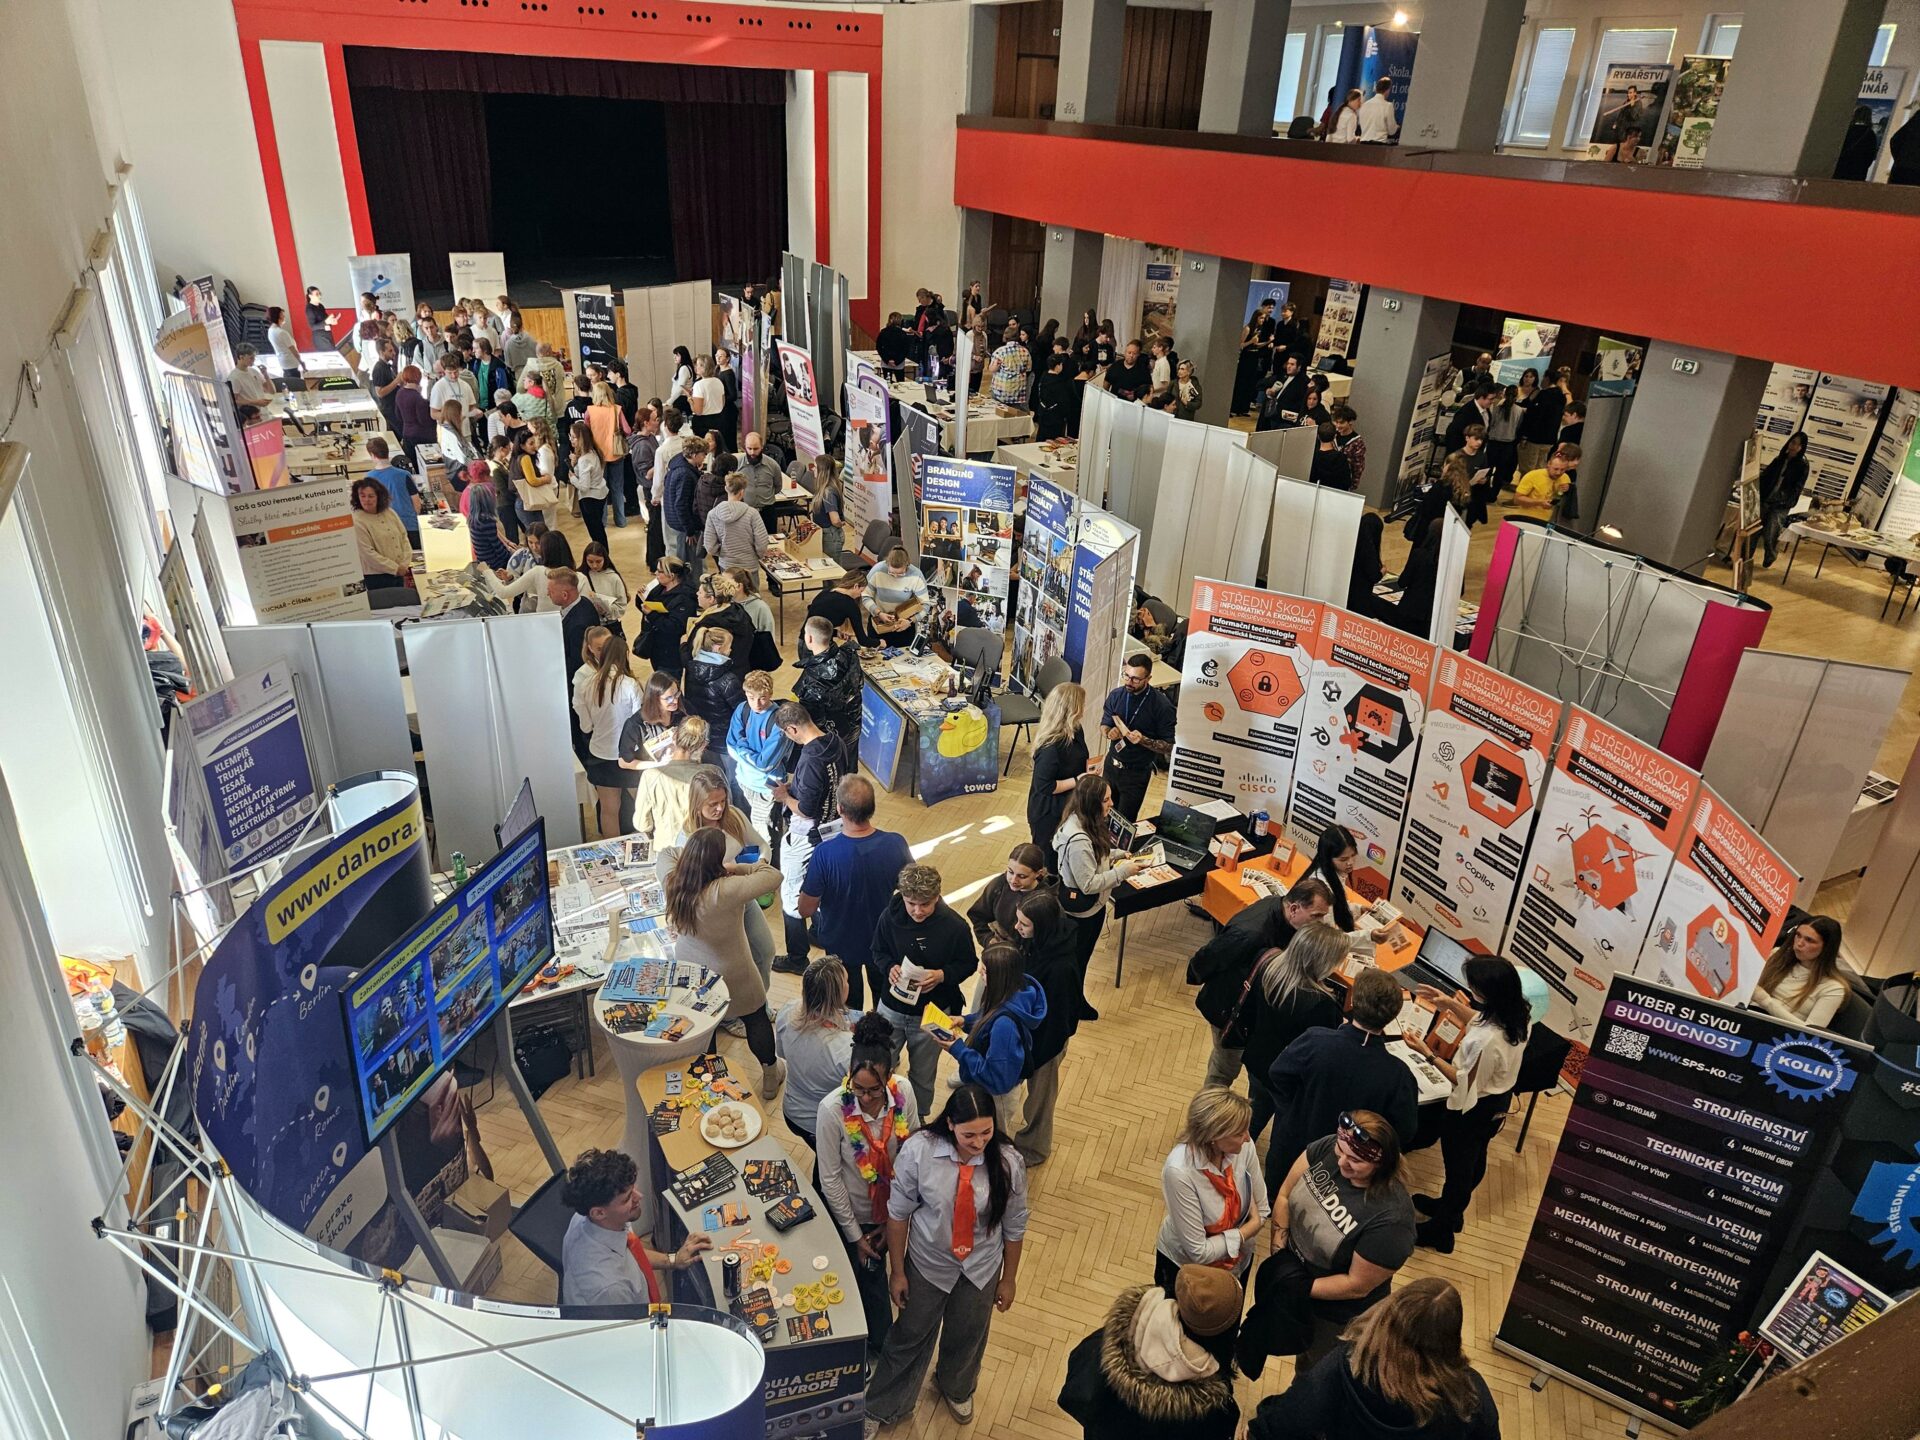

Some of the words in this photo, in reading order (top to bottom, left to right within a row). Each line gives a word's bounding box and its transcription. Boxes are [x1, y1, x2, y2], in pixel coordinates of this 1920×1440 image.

[1613, 70, 1664, 80] RYBÁŘSTVÍ
[578, 310, 598, 320] Škola,
[597, 313, 610, 321] kde
[579, 321, 586, 329] je
[586, 322, 614, 331] všechno
[926, 476, 961, 489] DESIGN
[927, 465, 975, 480] BRANDING
[234, 503, 250, 512] SOŠ
[257, 499, 272, 508] SOU
[272, 496, 304, 505] řemesel,
[304, 490, 326, 499] Kutná
[326, 487, 344, 495] Hora
[1077, 577, 1093, 596] ŠKOL
[1078, 566, 1095, 583] STŘE
[1220, 601, 1265, 616] INFORMATIKY
[1266, 610, 1273, 618] A
[1273, 612, 1315, 627] EKONOMIKY
[1221, 590, 1274, 610] STŘEDNÍ
[1276, 599, 1316, 620] ŠKOLA
[1211, 616, 1251, 631] Informační
[1251, 623, 1296, 639] technologie
[1212, 626, 1248, 639] Kybernetická
[1248, 633, 1281, 645] bezpečnost
[1276, 619, 1313, 633] ORGANIZACE
[1343, 619, 1391, 647] STŘEDNÍ
[1392, 636, 1430, 663] ŠKOLA
[1333, 645, 1369, 665] Informační
[1369, 659, 1409, 681] technologie
[1342, 631, 1383, 652] INFORMATIKY
[1383, 647, 1389, 655] A
[1389, 650, 1429, 670] EKONOMIKY
[1196, 677, 1219, 688] GNS3
[1463, 667, 1515, 700] STŘEDNÍ
[1515, 690, 1554, 719] ŠKOLA
[1452, 694, 1490, 718] Informační
[1489, 713, 1532, 740] technologie
[1461, 679, 1506, 706] INFORMATIKY
[1505, 701, 1511, 709] A
[1511, 704, 1553, 729] EKONOMIKY
[1454, 707, 1471, 718] Webové
[1470, 714, 1494, 732] technologie
[1497, 729, 1516, 742] systémy
[214, 745, 251, 775] KLEMPÍŘ
[216, 756, 256, 785] TRUHLÁŘ
[1431, 752, 1453, 773] OpenAI
[1590, 742, 1636, 773] INFORMATIKY
[1635, 770, 1641, 778] A
[1642, 772, 1688, 804] EKONOMIKY
[1592, 729, 1648, 768] STŘEDNÍ
[1646, 758, 1690, 796] ŠKOLA
[220, 774, 247, 796] TESAŘ
[223, 783, 253, 808] ZEDNÍK
[963, 782, 997, 793] tower
[1239, 783, 1277, 794] CISCO
[1574, 769, 1600, 788] Cestovní
[1599, 785, 1613, 797] ruch
[1616, 795, 1652, 821] rekreologie
[1577, 756, 1618, 786] Ekonomika
[1617, 781, 1623, 789] a
[1622, 784, 1664, 813] podnikání
[1644, 783, 1685, 813] ORGANIZACE
[225, 784, 271, 818] INSTALATÉR
[228, 806, 255, 830] MALÍŘ
[254, 802, 262, 813] A
[260, 779, 297, 809] LAKÝRNÍK
[230, 804, 277, 840] ELEKTRIKÁŘ
[476, 877, 492, 894] Digital
[525, 839, 537, 851] Hora
[1711, 829, 1748, 868] INFORMATIKY
[1745, 863, 1751, 871] A
[1750, 869, 1786, 908] EKONOMIKY
[1714, 813, 1759, 862] STŘEDNÍ
[1755, 851, 1790, 899] ŠKOLA
[1464, 861, 1496, 891] Copilot
[1697, 842, 1730, 878] Ekonomika
[1727, 874, 1733, 882] a
[1732, 879, 1763, 916] podnikání
[359, 970, 391, 1000] zahraniční
[298, 983, 332, 1021] Berlin
[1627, 990, 1676, 1016] VYBER
[1678, 1006, 1696, 1021] SI
[1697, 1012, 1742, 1035] SVOU
[1614, 1004, 1742, 1052] BUDOUCNOST
[1778, 1055, 1834, 1080] KOLÍN
[218, 1071, 240, 1121] Dublin
[1612, 1099, 1626, 1108] TOP
[1625, 1103, 1657, 1120] STROJAŘI
[313, 1105, 342, 1144] Rome
[1692, 1097, 1809, 1144] STROJÍRENSTVÍ
[1595, 1146, 1637, 1167] GYMNAZIÁLNÍ
[1637, 1162, 1649, 1172] TYP
[1649, 1167, 1671, 1180] VÝUKY
[1646, 1136, 1725, 1174] TECHNICKÉ
[1726, 1166, 1784, 1195] LYCEUM
[1727, 1139, 1736, 1149] 4
[1741, 1144, 1777, 1162] MATURITNÍ
[1775, 1155, 1794, 1168] OBOR
[299, 1164, 331, 1213] Valetta
[1311, 1161, 1359, 1236] LONDON
[1707, 1188, 1715, 1199] 4
[1721, 1194, 1755, 1211] MATURITNÍ
[1754, 1206, 1772, 1218] OBOR
[325, 1193, 353, 1234] praxe
[1601, 1200, 1640, 1222] BEZPEČNOST
[1645, 1219, 1667, 1232] PRÁVO
[1886, 1183, 1911, 1234] STŘEDNÍ
[327, 1210, 353, 1247] školy
[1706, 1214, 1763, 1244] LYCEUM
[1553, 1206, 1622, 1241] MECHANIK
[1623, 1233, 1741, 1290] ELEKTROTECHNIK
[1688, 1236, 1696, 1246] 4
[1702, 1241, 1734, 1259] MATURITNÍ
[1734, 1254, 1751, 1266] OBOR
[1670, 1281, 1679, 1291] 4
[1595, 1273, 1652, 1303] STROJNÍ
[1651, 1297, 1722, 1334] MECHANIK
[1652, 1323, 1661, 1333] 3
[1581, 1315, 1635, 1346] STROJNÍ
[1635, 1338, 1703, 1377] MECHANIK
[789, 1375, 803, 1386] A
[804, 1363, 861, 1383] CESTUJ
[1636, 1364, 1643, 1373] 1
[777, 1377, 840, 1398] EVROPĚ
